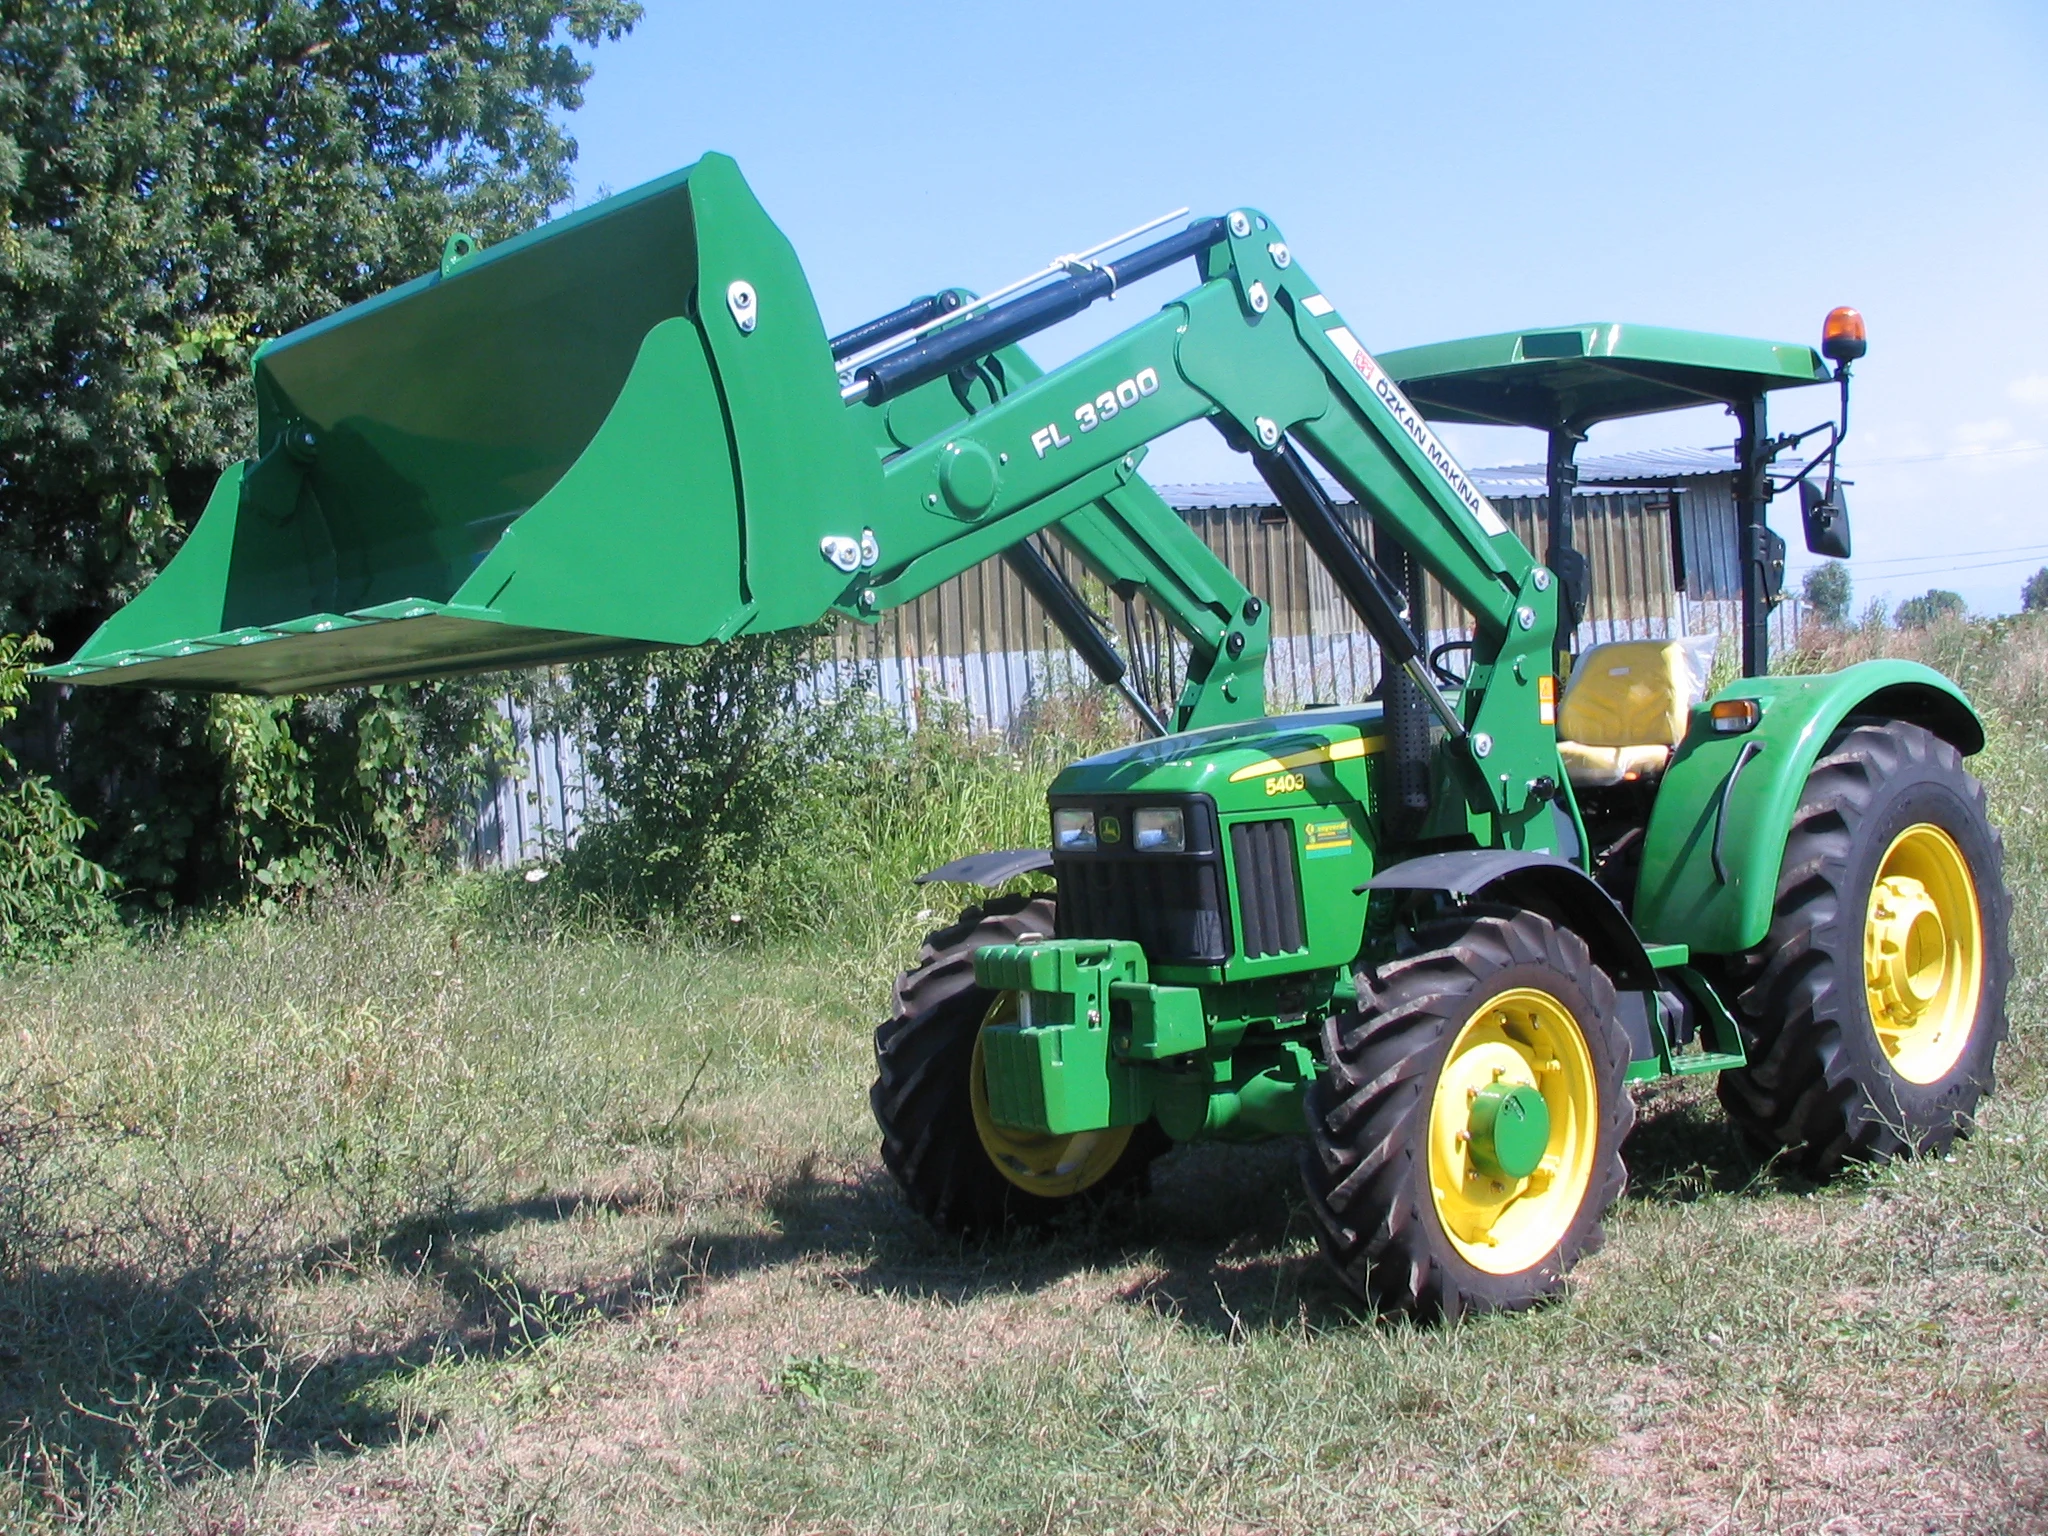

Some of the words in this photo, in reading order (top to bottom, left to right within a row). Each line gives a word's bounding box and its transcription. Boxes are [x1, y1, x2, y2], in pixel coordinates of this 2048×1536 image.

[1030, 422, 1072, 460] FL
[1074, 366, 1160, 433] 3300
[1375, 378, 1427, 445] ÖZKAN
[1266, 773, 1305, 796] 5403
